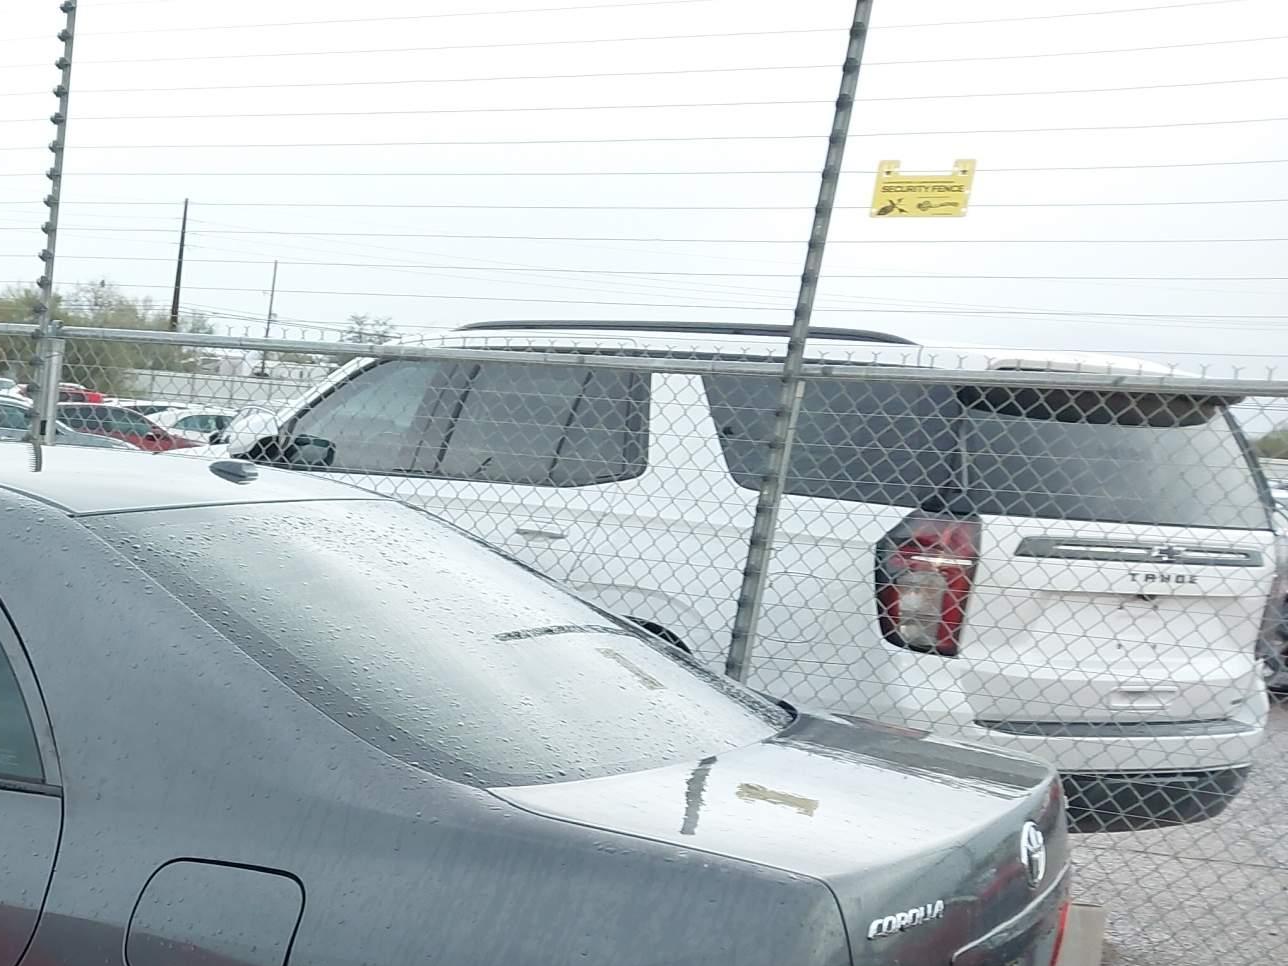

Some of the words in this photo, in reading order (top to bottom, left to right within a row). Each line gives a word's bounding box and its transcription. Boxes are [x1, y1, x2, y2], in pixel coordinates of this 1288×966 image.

[880, 184, 931, 193] SECURITY
[932, 184, 965, 193] FENCE
[1127, 572, 1199, 585] TAHOE
[867, 899, 945, 939] COROLLA
